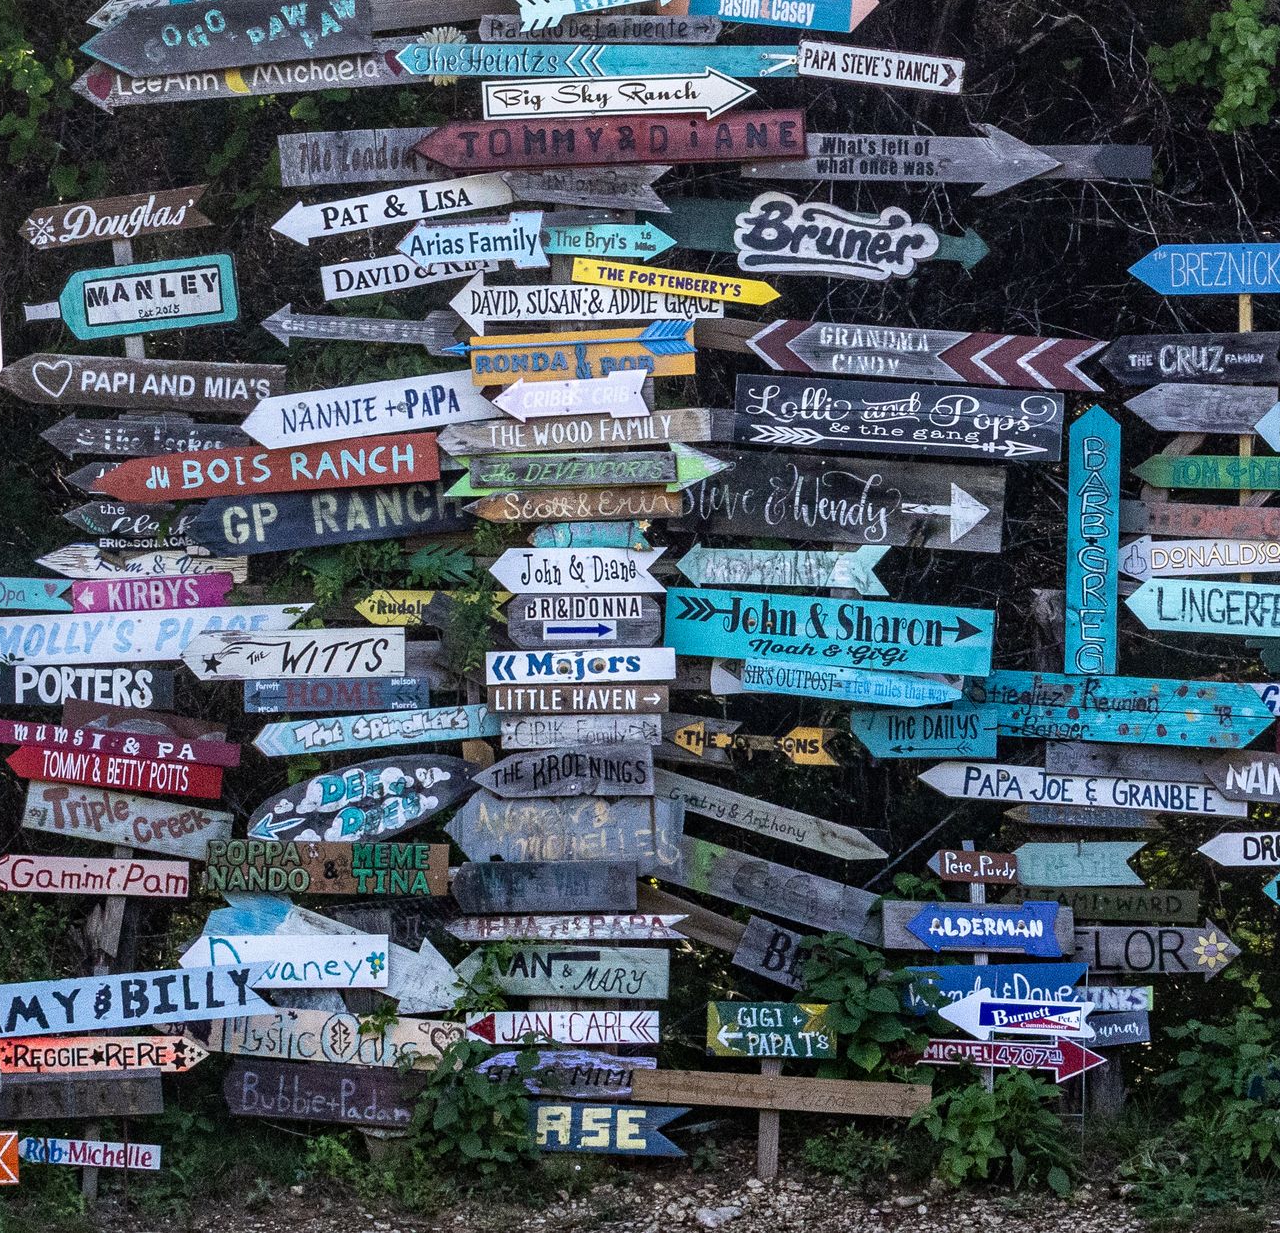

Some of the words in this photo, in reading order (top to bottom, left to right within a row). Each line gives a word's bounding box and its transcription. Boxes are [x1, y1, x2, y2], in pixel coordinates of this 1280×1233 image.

[803, 49, 839, 71] PAPA
[843, 54, 891, 78] STEVE'S
[897, 59, 938, 84] RANCH
[493, 89, 542, 108] Big
[552, 85, 611, 106] Sky
[618, 83, 700, 104] Ranch
[459, 125, 605, 158] TOMMY
[823, 138, 877, 155] What's
[881, 138, 911, 154] left
[916, 138, 930, 154] of
[817, 158, 855, 175] what
[859, 160, 898, 174] once
[410, 236, 463, 257] Arias
[470, 228, 538, 256] Family
[555, 231, 581, 248] The
[743, 200, 926, 265] Bruner
[87, 271, 217, 308] MANLEY
[334, 264, 410, 292] DAVID
[598, 267, 624, 282] THE
[629, 269, 741, 296] FORTENBERRY'S
[527, 289, 582, 315] SUSAN
[820, 326, 928, 352] GRANDMA
[832, 356, 899, 374] CINDY
[1129, 353, 1153, 367] THE
[1159, 345, 1224, 372] CRUZ
[81, 371, 135, 393] PAPI
[143, 373, 194, 397] AND
[204, 376, 271, 399] MIA'S
[282, 396, 376, 434] NANNIE
[861, 392, 921, 422] and
[490, 425, 533, 447] THE
[538, 421, 592, 443] WOOD
[600, 416, 671, 441] FAMILY
[861, 424, 905, 437] the
[912, 426, 979, 443] gang
[183, 455, 272, 488] BOIS
[291, 444, 414, 480] RANCH
[100, 504, 125, 515] the
[223, 502, 278, 544] GP
[521, 553, 562, 586] John
[594, 556, 637, 580] Diane
[107, 579, 199, 610] KIRBYS
[723, 598, 797, 637] John
[837, 604, 943, 646] Sharon
[247, 650, 270, 665] THE
[282, 638, 388, 674] WITTS
[749, 639, 817, 657] Noah
[14, 666, 153, 708] PORTERS
[392, 678, 416, 686] Nelson
[392, 701, 417, 709] Morris
[495, 689, 561, 711] LITTLE
[573, 689, 636, 710] HAVEN
[683, 730, 717, 747] THE
[43, 750, 88, 779] TOMMY
[107, 757, 145, 786] BETTY
[149, 761, 188, 791] POTTS
[492, 760, 524, 788] THE
[964, 768, 1022, 799] PAPA
[1030, 771, 1073, 805] JOE
[208, 841, 302, 867] POPPA
[352, 842, 430, 870] MEME
[123, 863, 188, 894] Pam
[208, 865, 310, 894] NANDO
[352, 868, 431, 895] TINA
[928, 915, 1044, 938] ALDERMAN
[122, 969, 251, 1020] BILLY
[992, 1007, 1051, 1026] Burnett
[1020, 1022, 1069, 1030] Commissioner
[13, 1044, 87, 1067] REGGIE
[996, 1047, 1050, 1064] 4707
